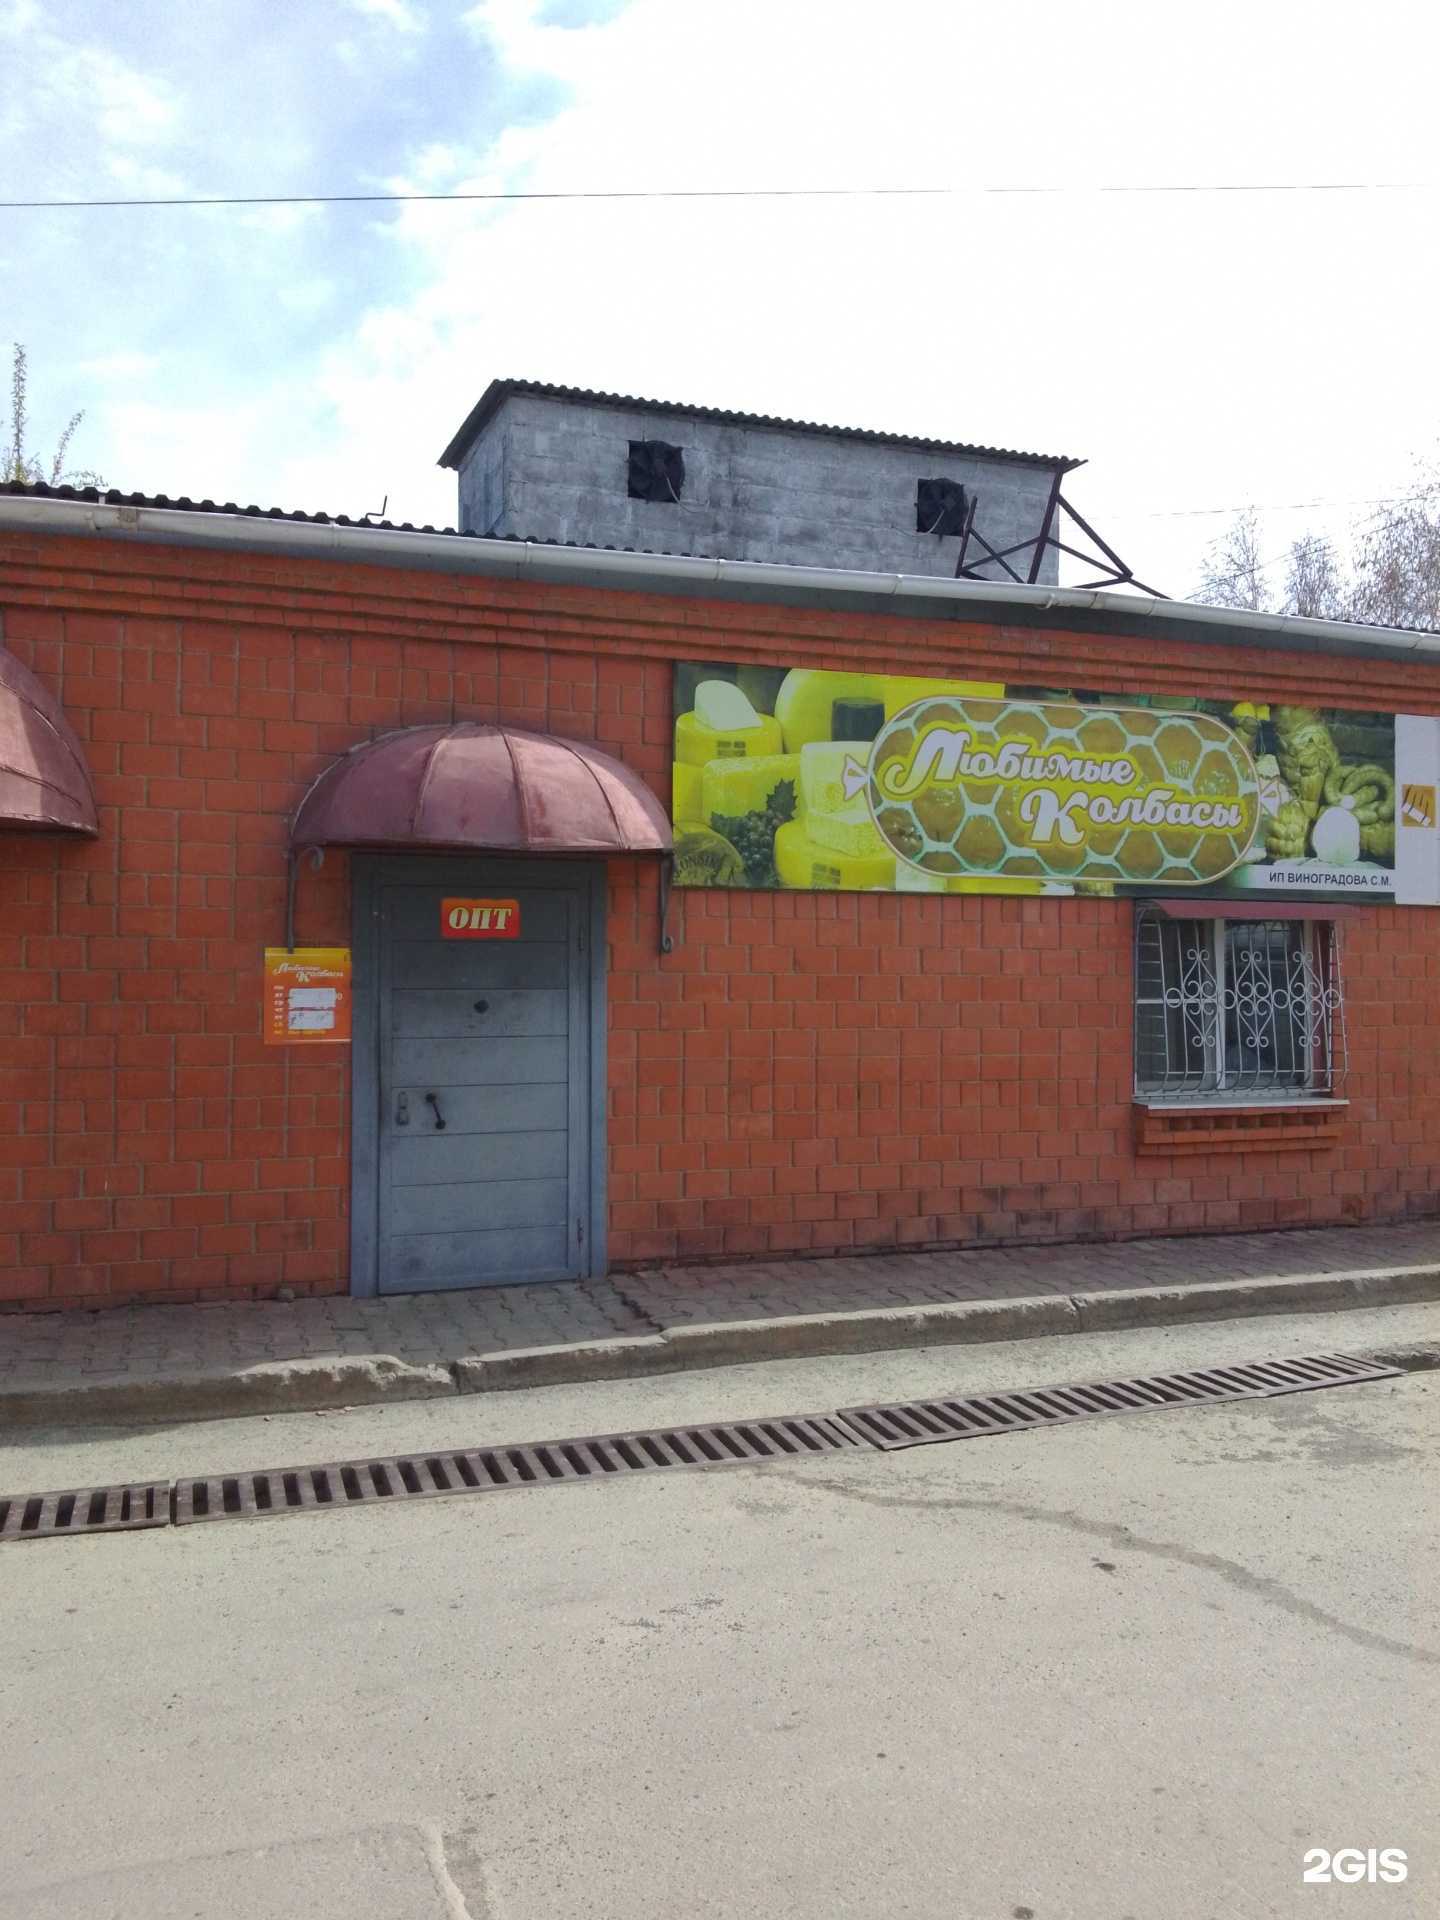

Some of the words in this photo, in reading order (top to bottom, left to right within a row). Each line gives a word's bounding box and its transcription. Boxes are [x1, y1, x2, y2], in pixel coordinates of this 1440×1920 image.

[884, 728, 1135, 795] Любимые
[1020, 788, 1242, 844] Колбасы
[1269, 872, 1285, 884] ИП
[1287, 872, 1368, 886] ВИНОГРАДОВА
[1370, 875, 1392, 887] С.М.
[448, 906, 513, 930] ОПТ
